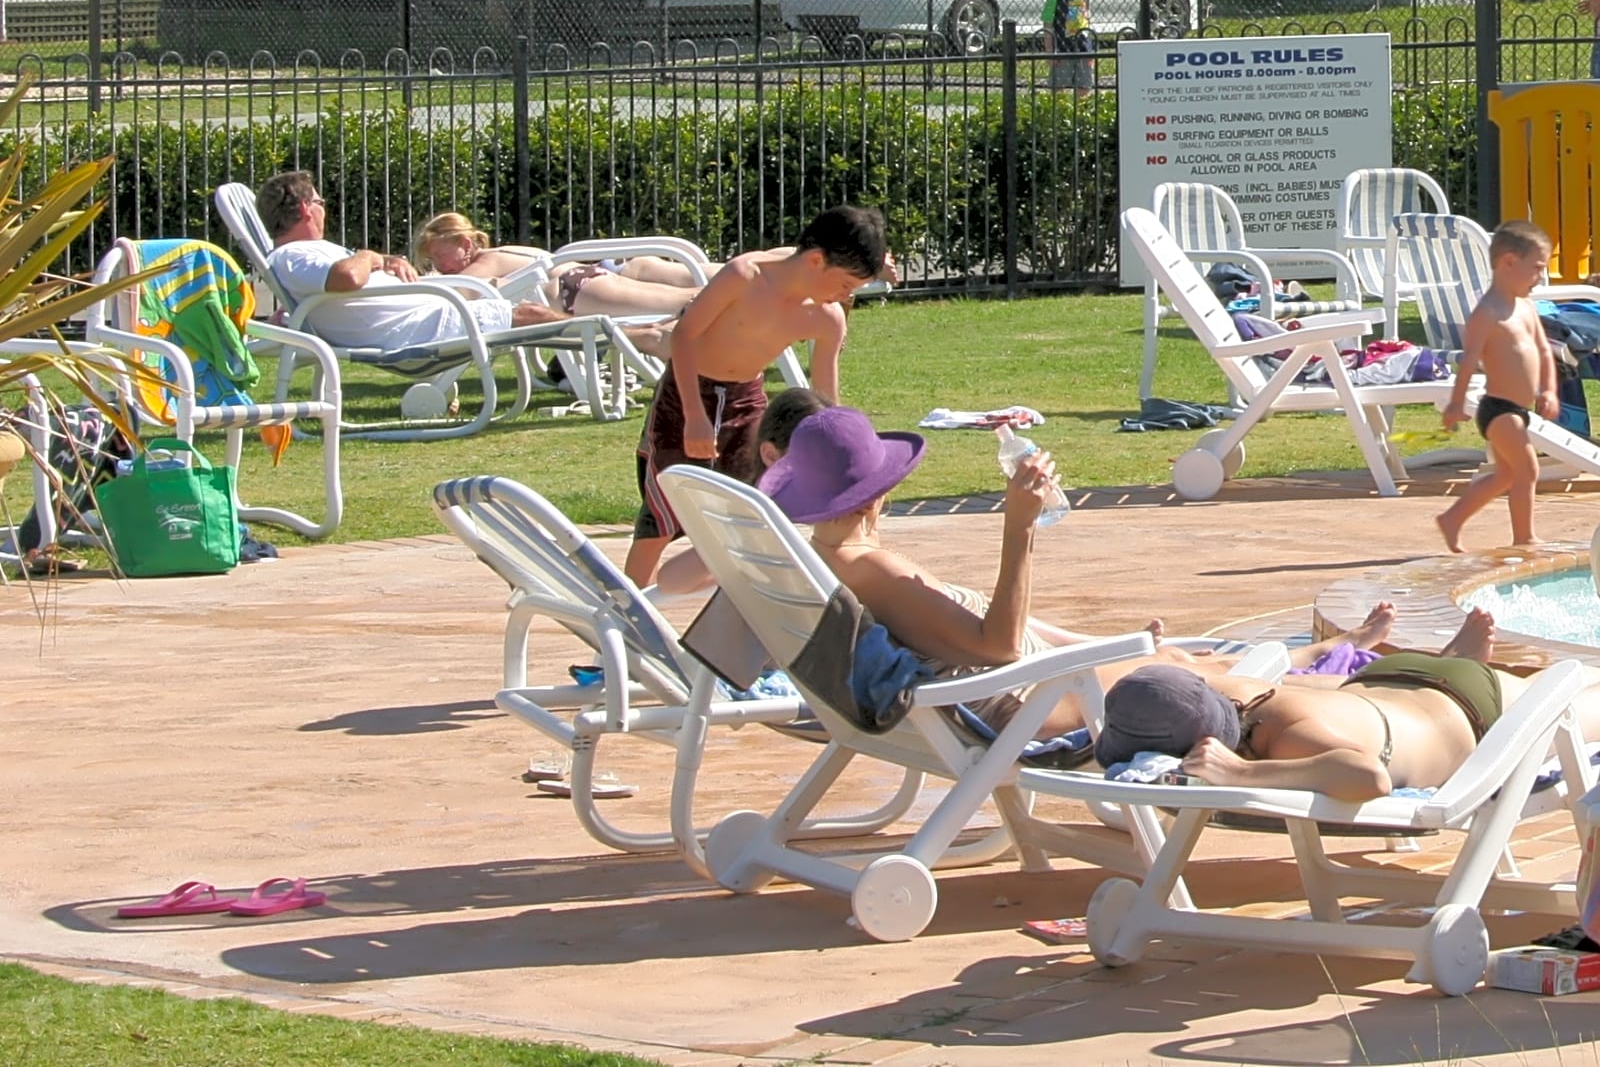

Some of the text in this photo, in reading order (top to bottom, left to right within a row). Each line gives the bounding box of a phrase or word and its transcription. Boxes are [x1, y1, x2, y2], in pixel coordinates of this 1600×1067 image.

[1166, 47, 1343, 66] POOL RULES
[1154, 71, 1192, 80] POOL
[1195, 69, 1242, 79] HOURS
[1246, 68, 1296, 77] 8.00am
[1306, 66, 1356, 76] 8.00pm
[1147, 87, 1164, 95] FOR
[1204, 85, 1216, 93] OF
[1353, 80, 1373, 88] ONLY
[1149, 95, 1176, 103] YOUNG
[1179, 94, 1218, 102] CHILDREN
[1221, 93, 1242, 101] MUST
[1321, 89, 1334, 97] ALL
[1145, 108, 1369, 125] NO PUSHING, RUNNING, DIVING OR BOMBING
[1145, 126, 1329, 142] NO SURFING EQUIPMENT OR BALLS
[1146, 149, 1337, 165] NO ALCOHOL OR GLASS PRODUCTS
[1190, 161, 1317, 175] ALLOWED IN POOL AREA
[1277, 181, 1317, 192] BABIES)
[1275, 191, 1330, 202] COSTUMES
[1258, 211, 1292, 222] OTHER
[1295, 209, 1335, 220] GUESTS
[1274, 222, 1288, 232] OF
[1291, 220, 1323, 231] THESE
